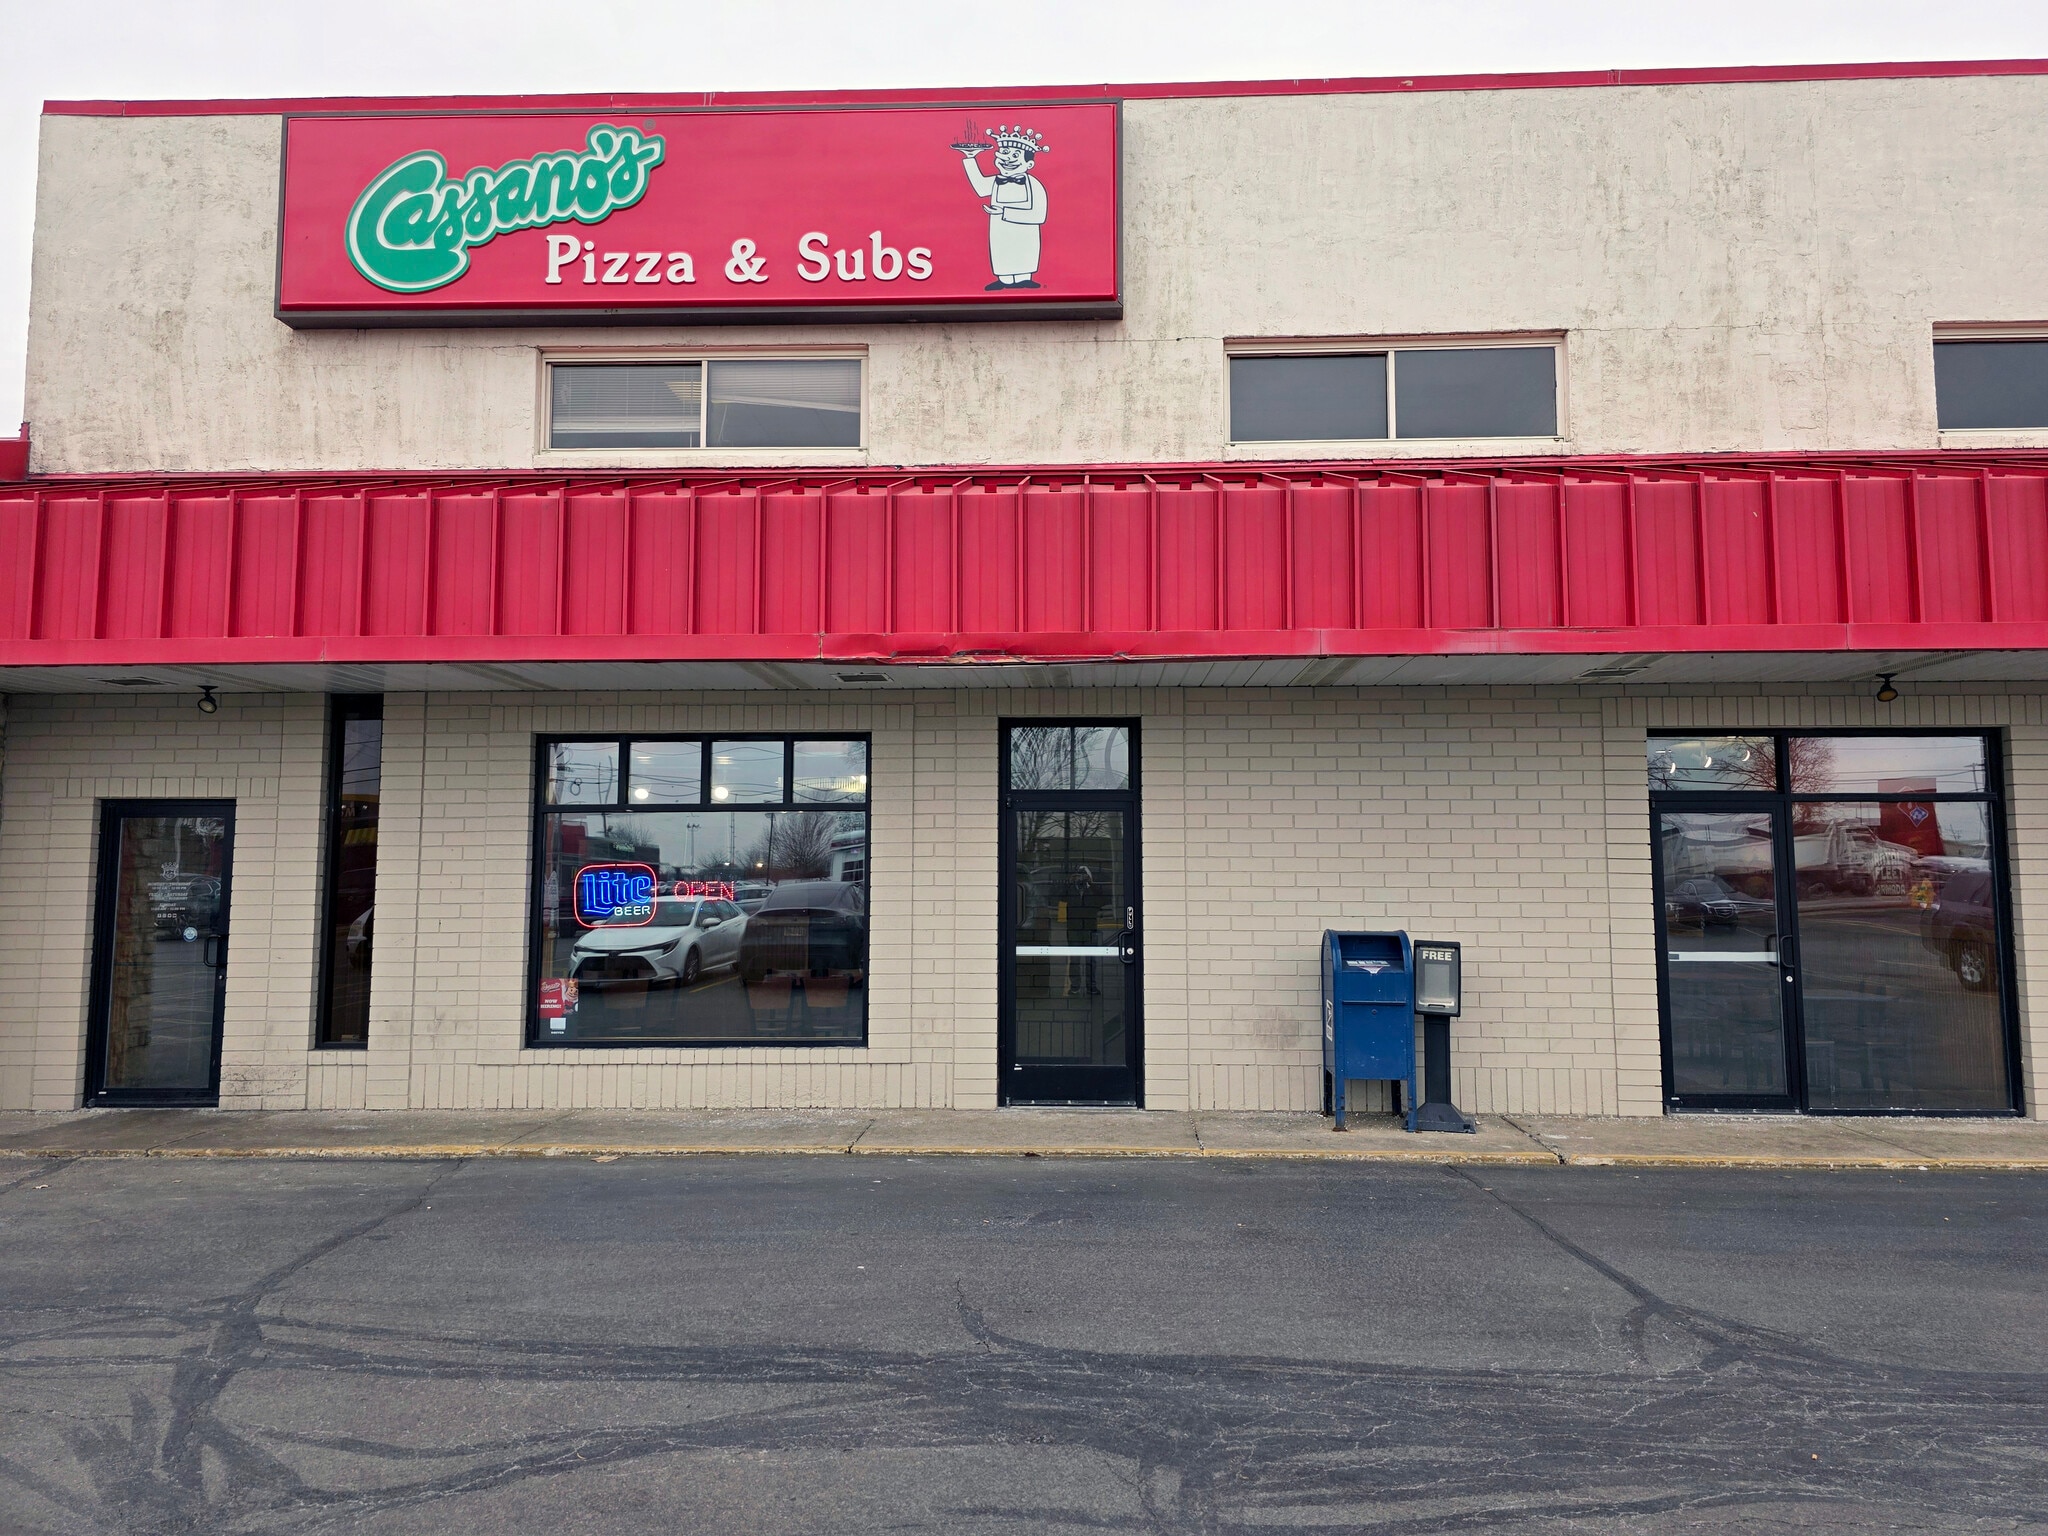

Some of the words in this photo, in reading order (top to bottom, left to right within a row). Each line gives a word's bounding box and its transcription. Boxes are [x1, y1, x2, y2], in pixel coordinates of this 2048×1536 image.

[345, 123, 666, 293] Cassano's
[545, 234, 696, 284] Pizza
[724, 238, 769, 283] &
[797, 230, 933, 282] Subs
[583, 872, 651, 914] Lite
[674, 880, 735, 901] OPEN
[614, 905, 651, 917] BEER
[1422, 950, 1452, 961] FREE
